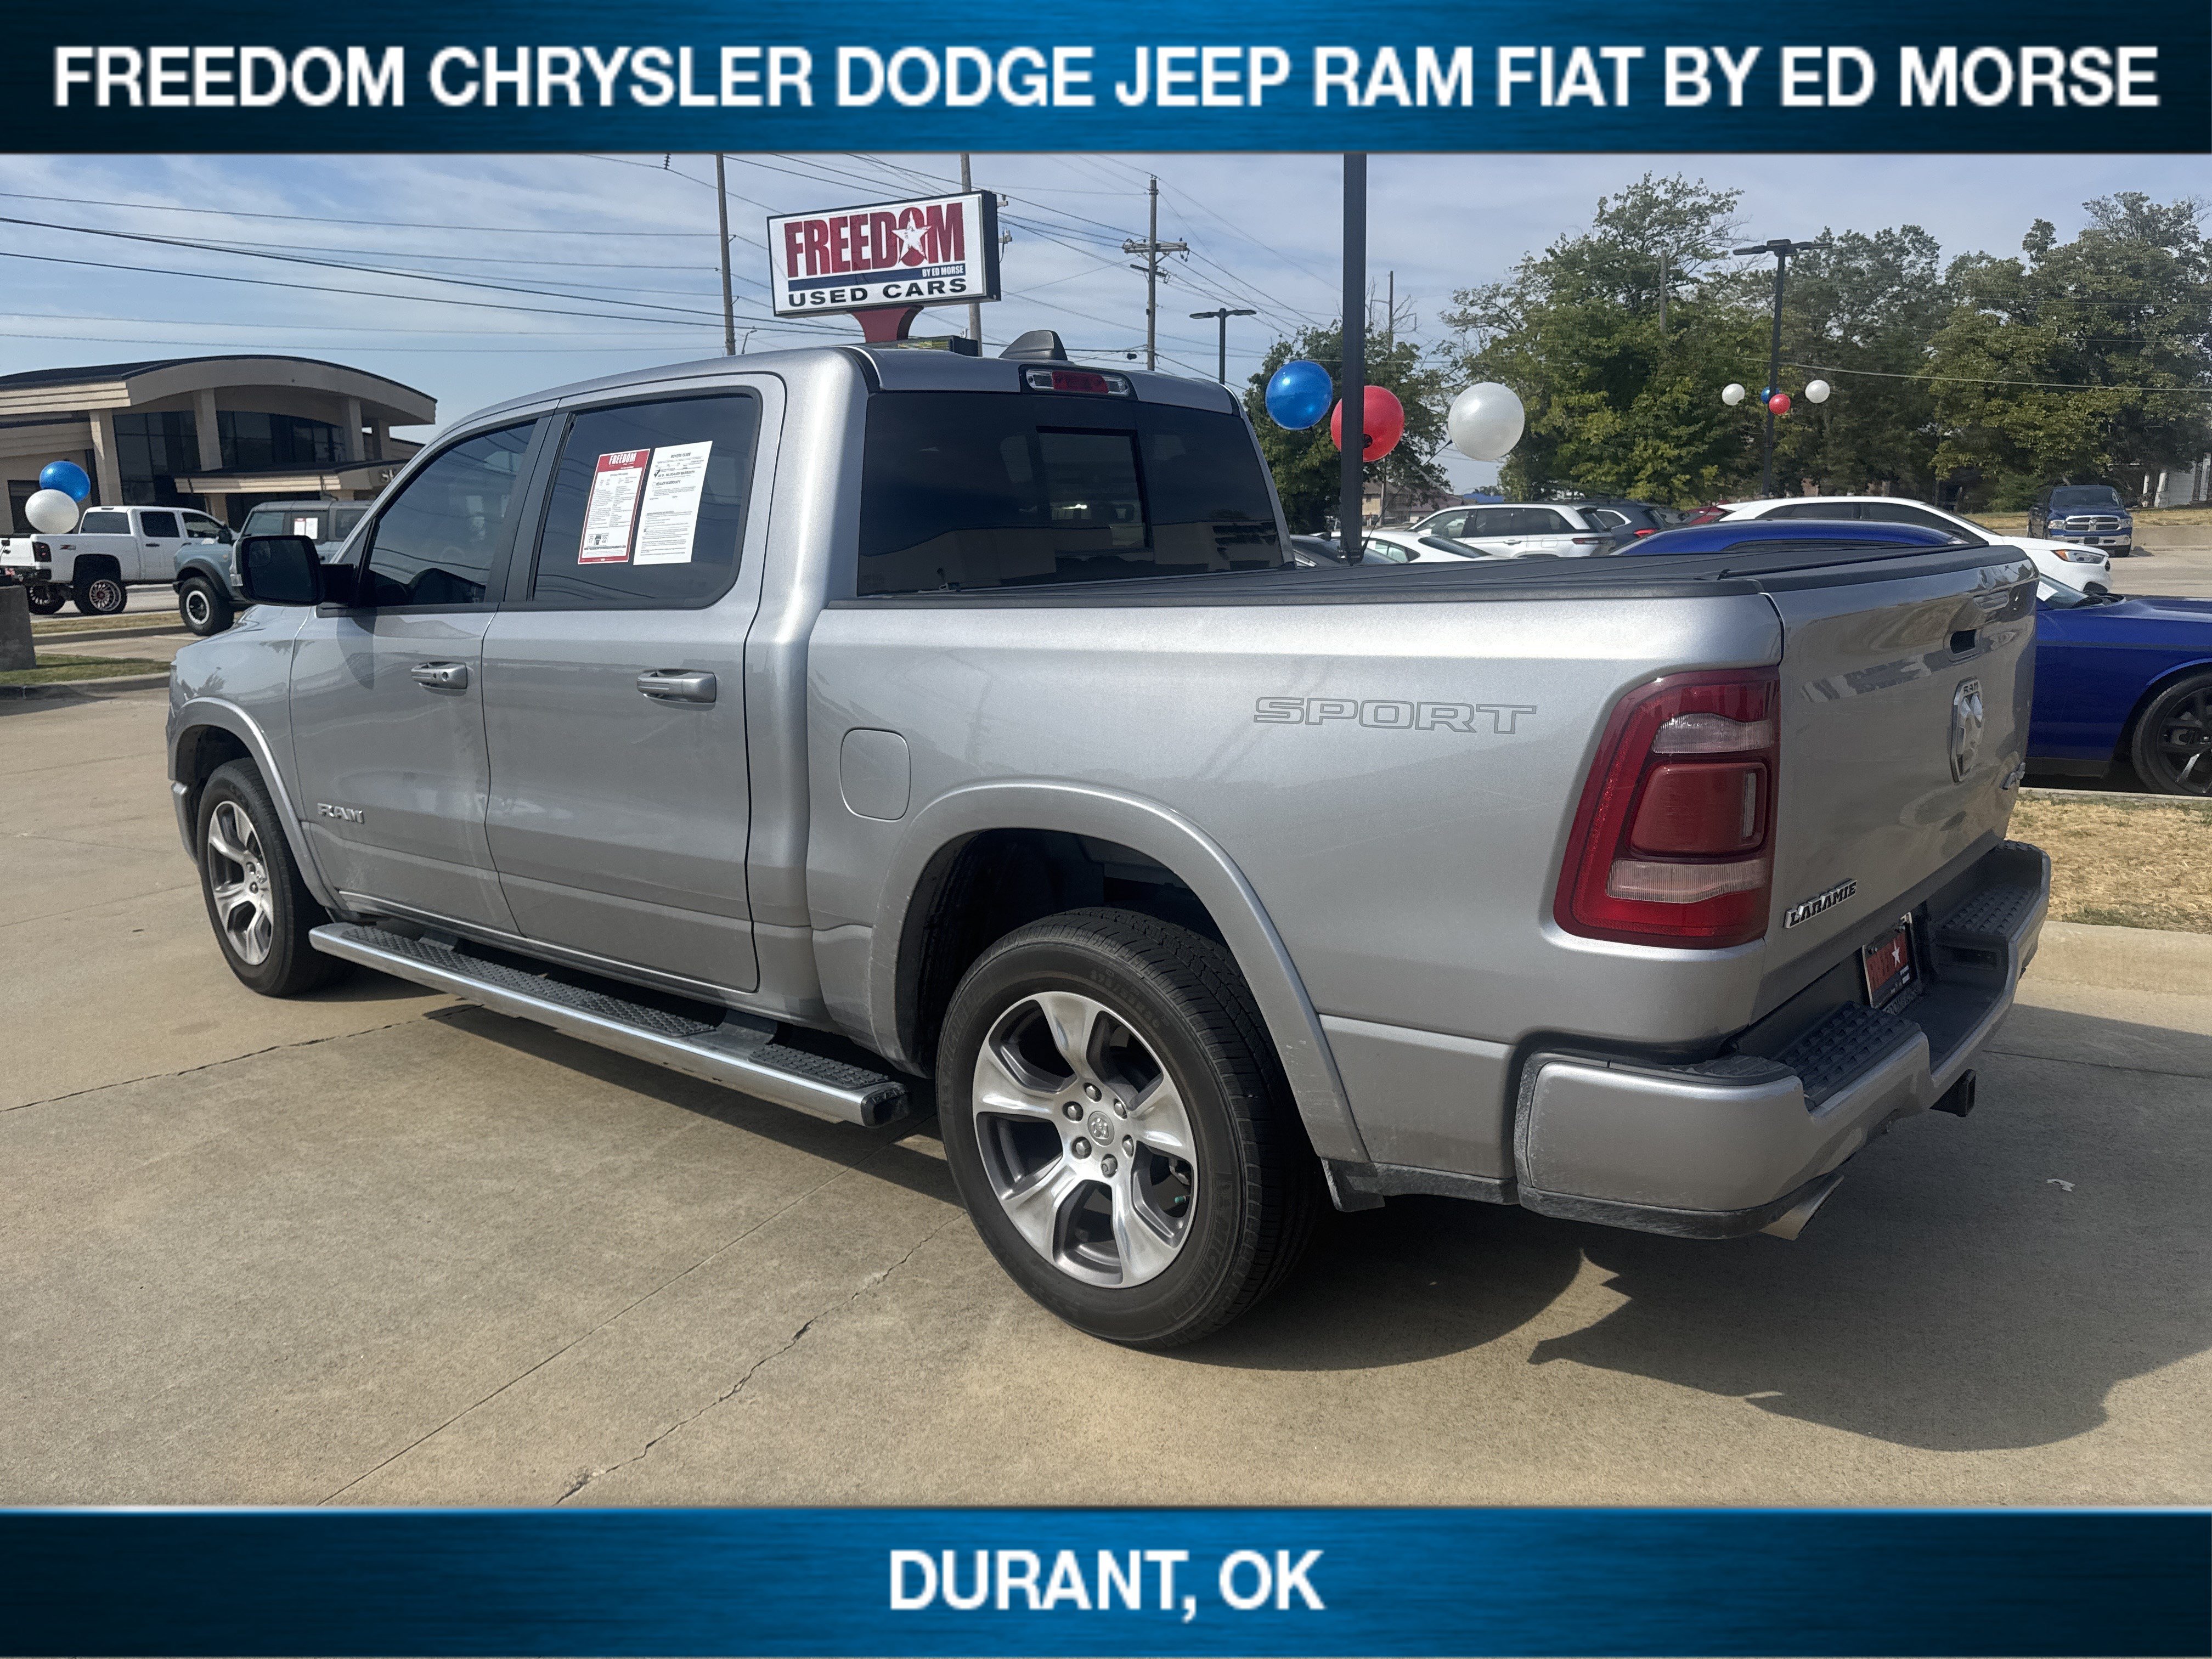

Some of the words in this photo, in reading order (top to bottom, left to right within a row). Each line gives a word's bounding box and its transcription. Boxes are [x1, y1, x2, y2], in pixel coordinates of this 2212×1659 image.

[784, 202, 966, 278] FREEDOM
[922, 269, 930, 277] BY
[932, 267, 940, 276] ED
[941, 265, 964, 275] MORSE
[789, 287, 868, 307] USED
[883, 278, 967, 300] CARS
[608, 452, 637, 465] FREEDOM
[1963, 681, 1979, 694] RAM
[1254, 696, 1537, 735] SPORT
[317, 802, 364, 825] RAM
[1785, 879, 1858, 928] LARAMIE
